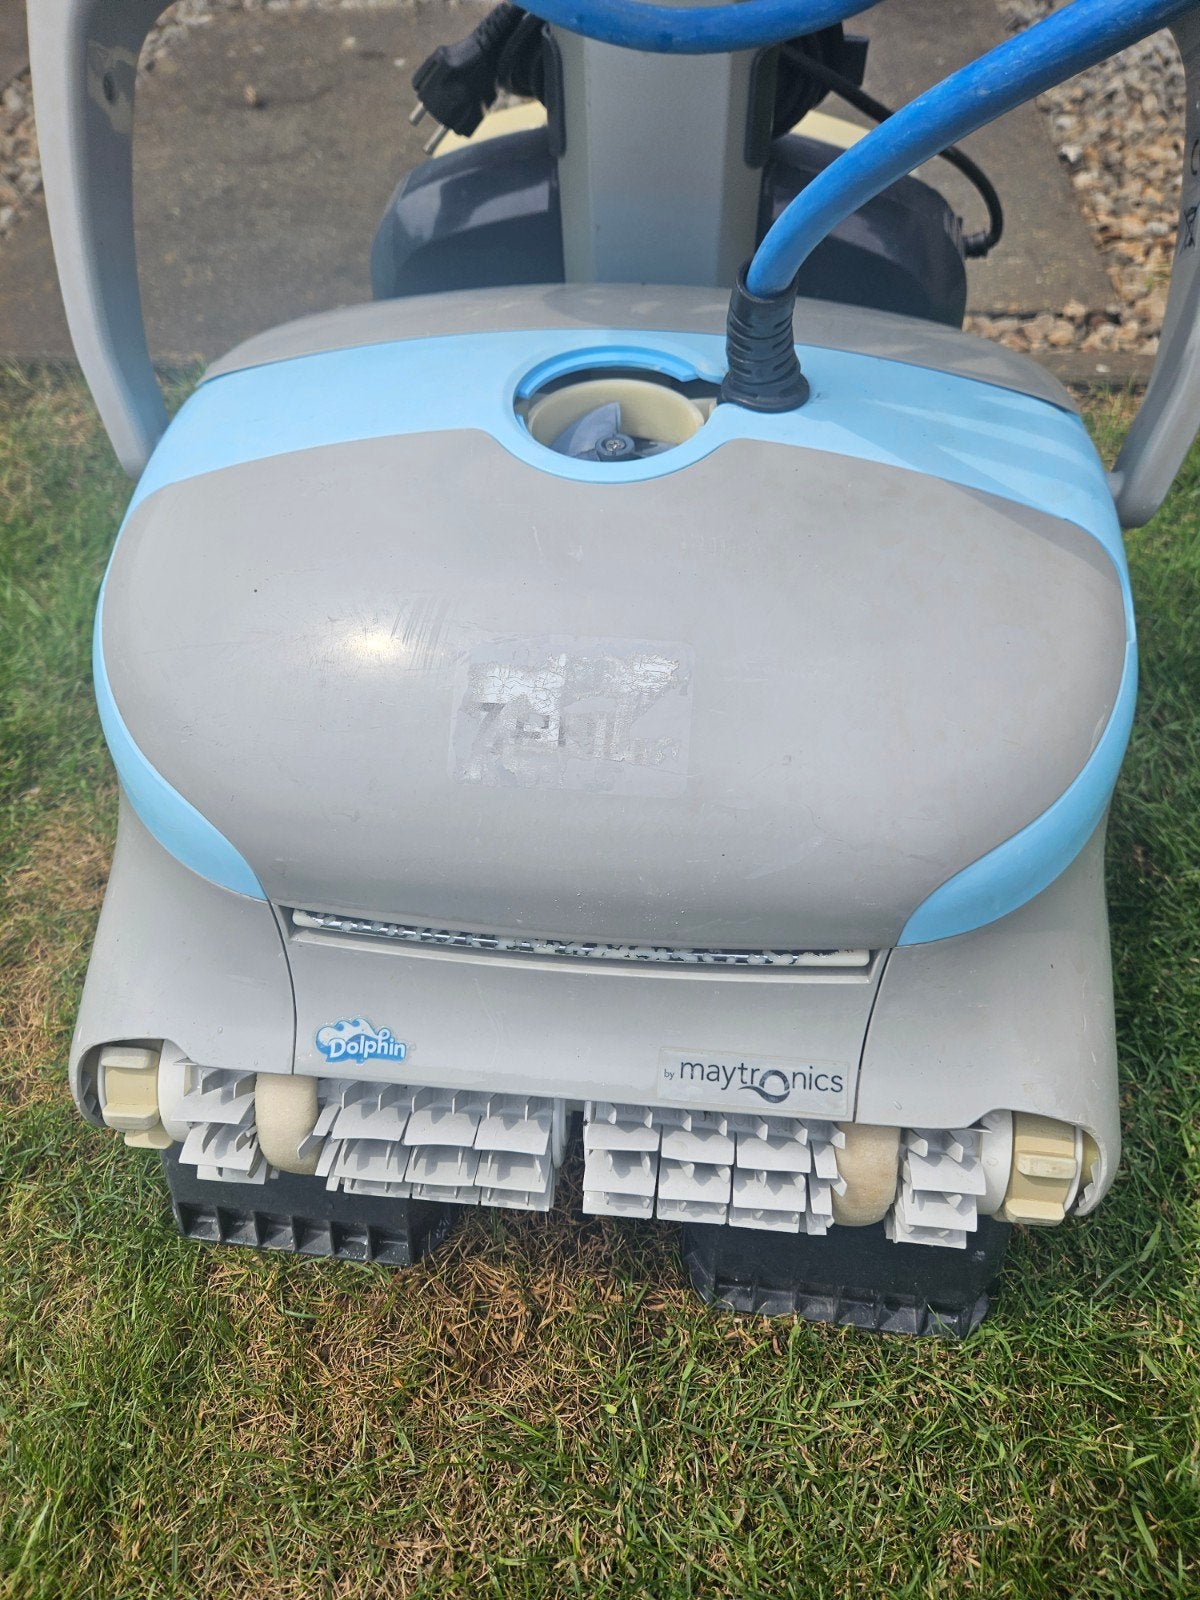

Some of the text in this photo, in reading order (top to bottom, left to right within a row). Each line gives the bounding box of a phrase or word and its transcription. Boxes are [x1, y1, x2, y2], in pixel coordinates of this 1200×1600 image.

[328, 1029, 406, 1059] Dolphin
[663, 1061, 844, 1104] by maytronics
